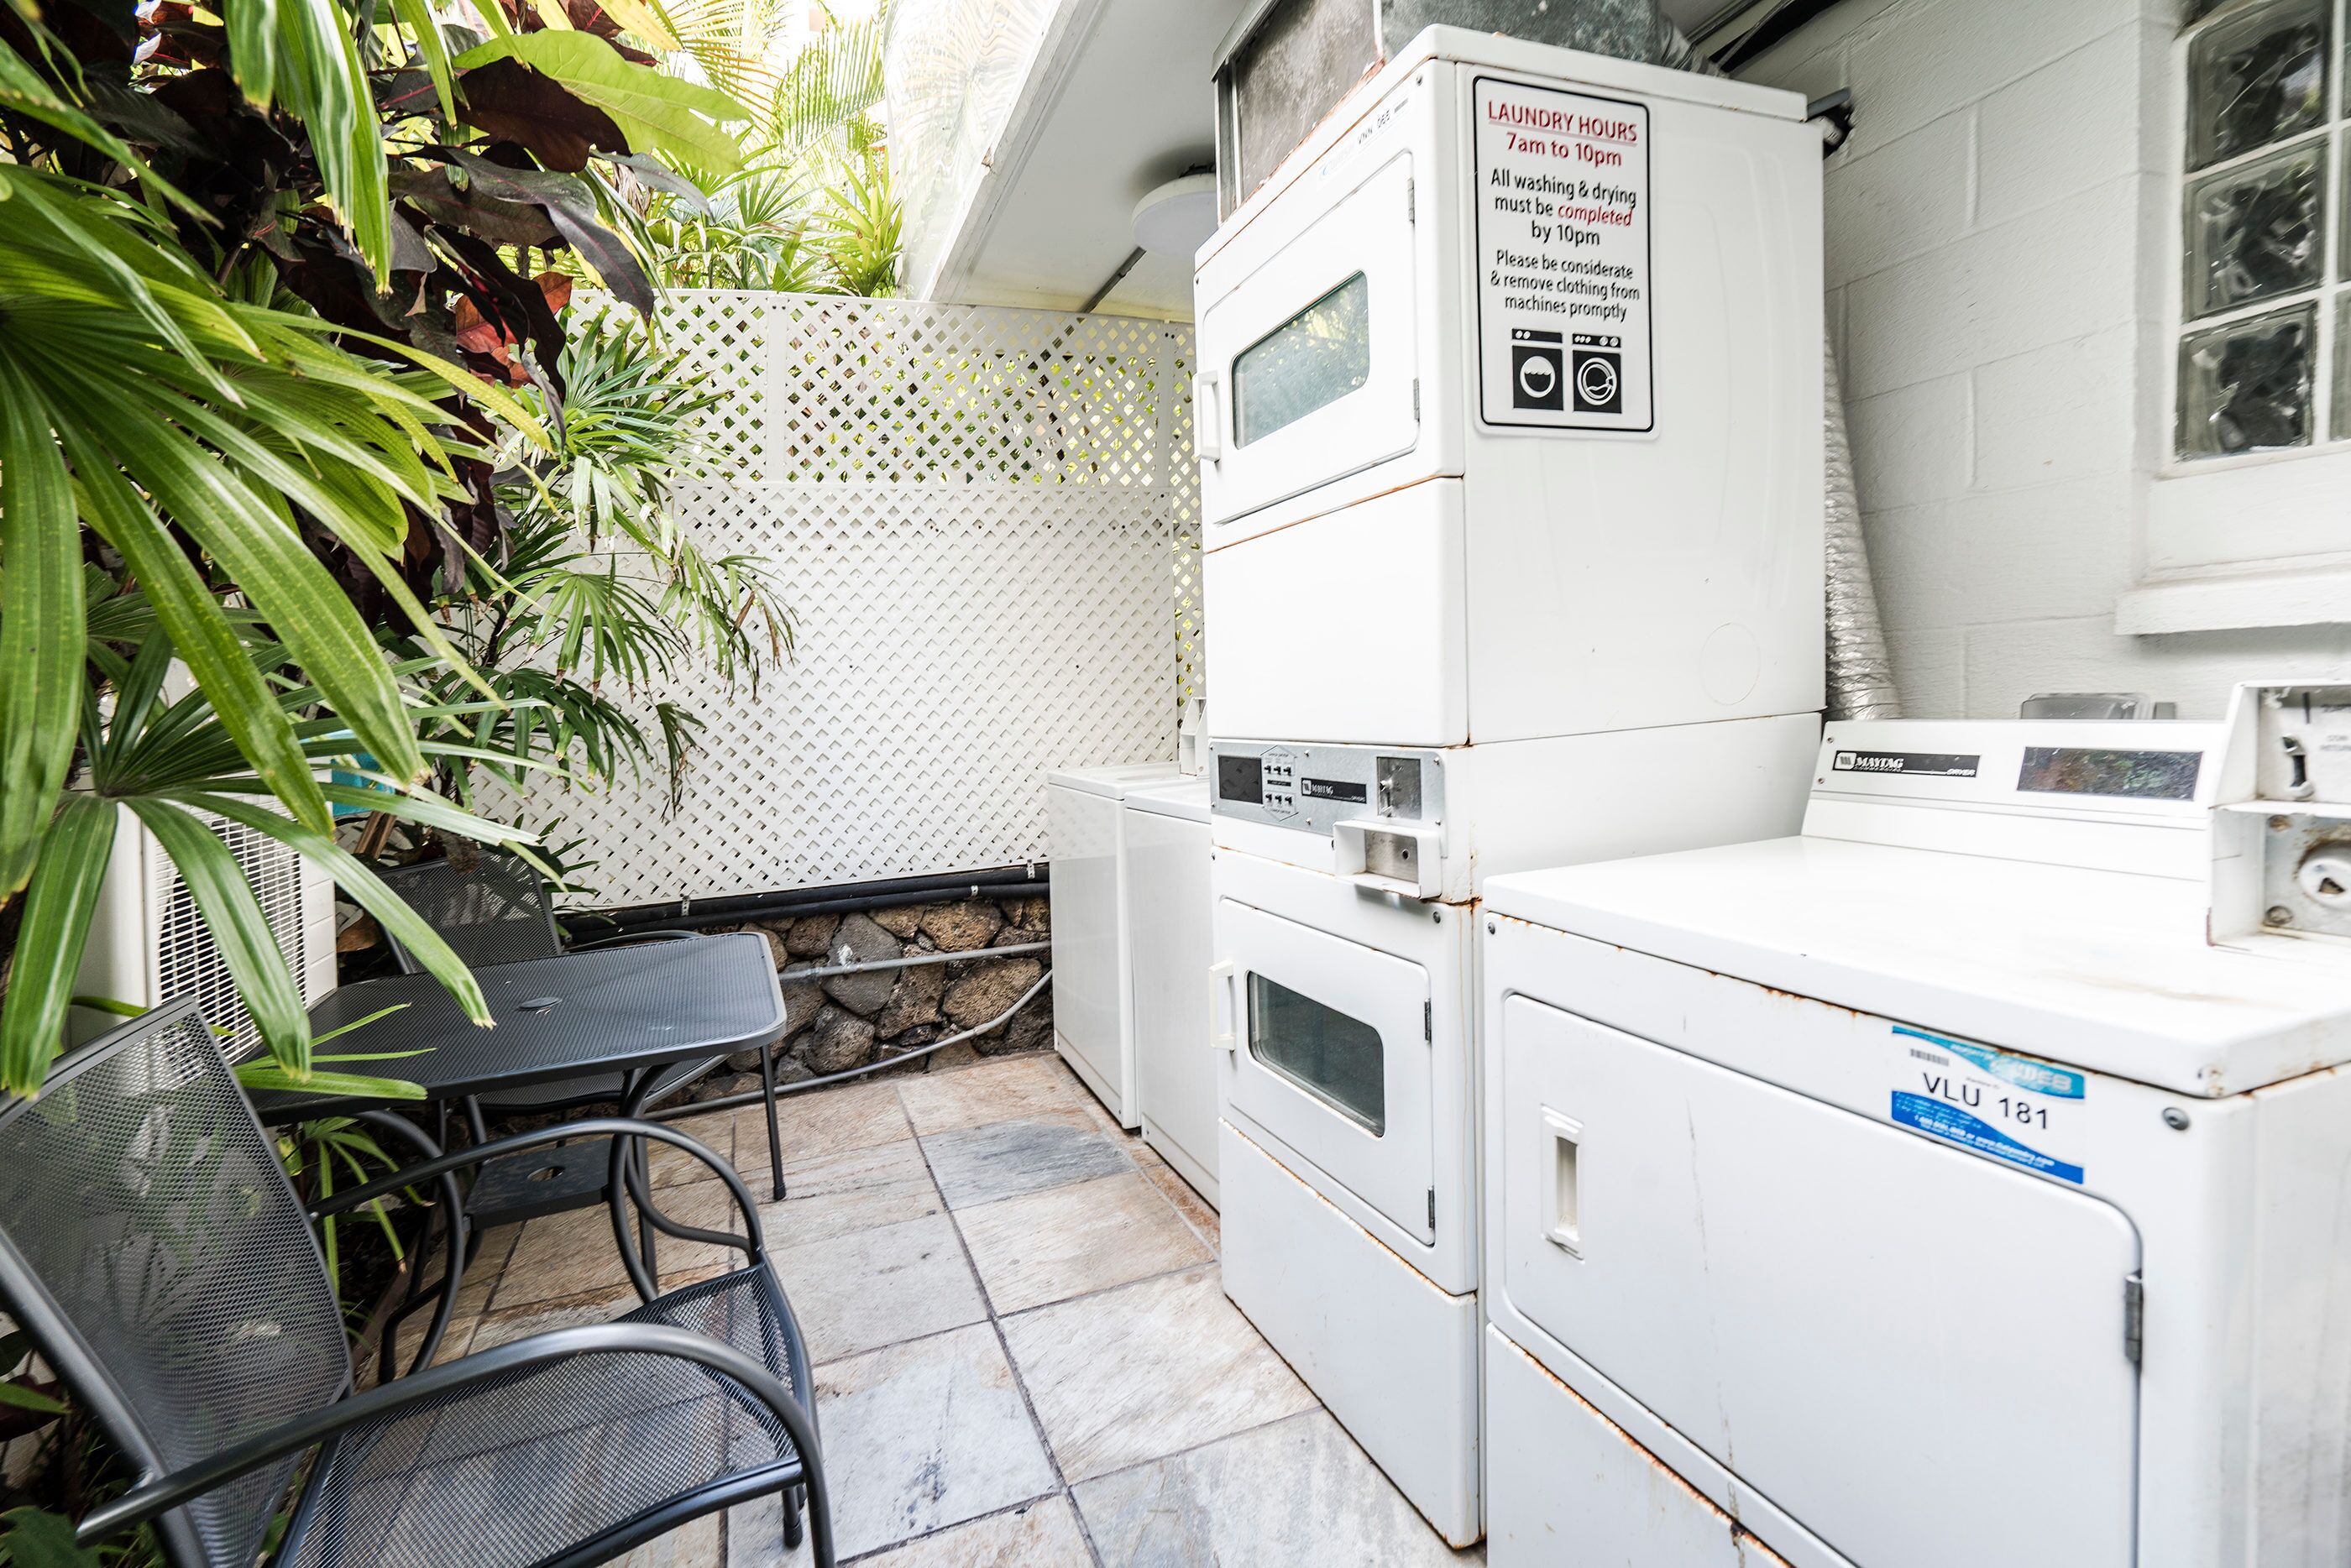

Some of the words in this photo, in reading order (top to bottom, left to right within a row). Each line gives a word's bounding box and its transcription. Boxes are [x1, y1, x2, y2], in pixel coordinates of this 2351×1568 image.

[1488, 100, 1574, 133] LAUNDRY
[1579, 114, 1638, 142] HOURS
[1505, 132, 1545, 155] 7am
[1551, 140, 1569, 159] to
[1575, 143, 1622, 168] 10pm
[1490, 168, 1511, 187] All
[1514, 173, 1574, 201] washing
[1578, 180, 1589, 197] &
[1593, 181, 1637, 209] drying
[1495, 195, 1531, 214] must
[1536, 197, 1553, 216] be
[1558, 203, 1633, 227] completed
[1532, 220, 1552, 243] by
[1558, 224, 1600, 248] 10pm
[1496, 249, 1538, 269] Please
[1542, 253, 1558, 271] be
[1561, 259, 1634, 280] considerate
[1490, 270, 1500, 286] &
[1504, 274, 1553, 292] remove
[1557, 277, 1607, 301] clothing
[1610, 281, 1640, 301] from
[1505, 294, 1567, 314] machines
[1570, 302, 1627, 323] promptly
[1855, 757, 1903, 768] MAYTAG
[1946, 768, 1976, 776] DRYER
[1923, 1072, 1980, 1107] VLU
[1999, 1097, 2048, 1130] 181
